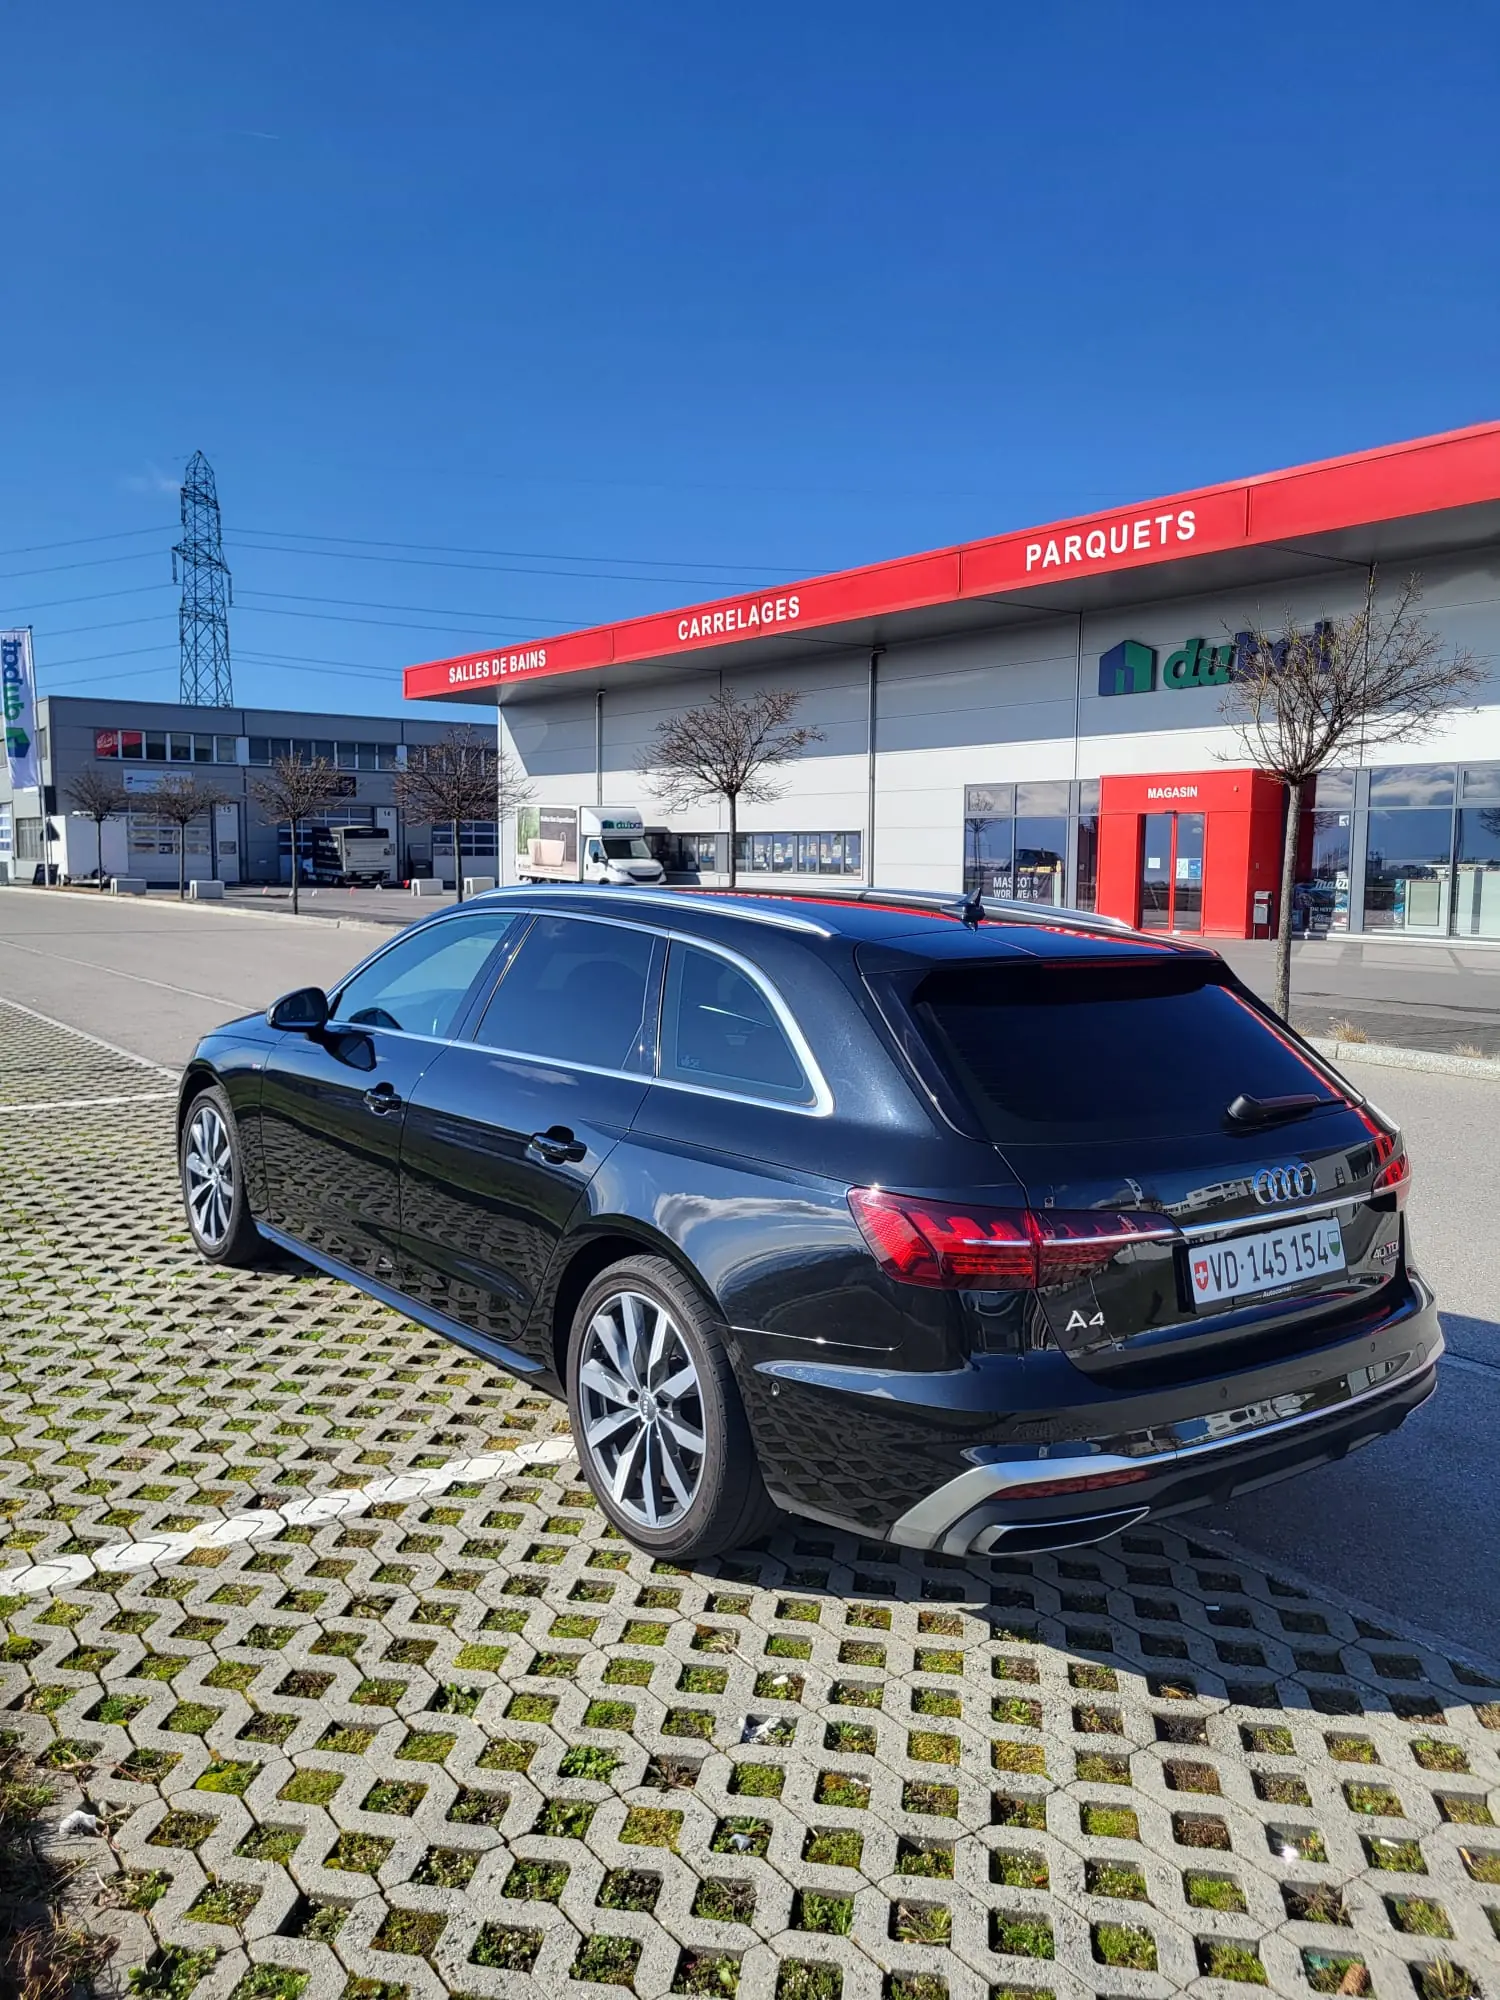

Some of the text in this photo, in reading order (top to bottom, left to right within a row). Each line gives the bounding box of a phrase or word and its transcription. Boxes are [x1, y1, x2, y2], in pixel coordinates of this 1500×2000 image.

[1025, 510, 1196, 572] PARQUETS
[677, 595, 800, 641] CARRELAGES
[448, 649, 546, 684] SALLES DE BAINS
[1147, 786, 1198, 799] MAGASIN
[993, 889, 1038, 899] WORWEAR
[1064, 1309, 1105, 1332] A4
